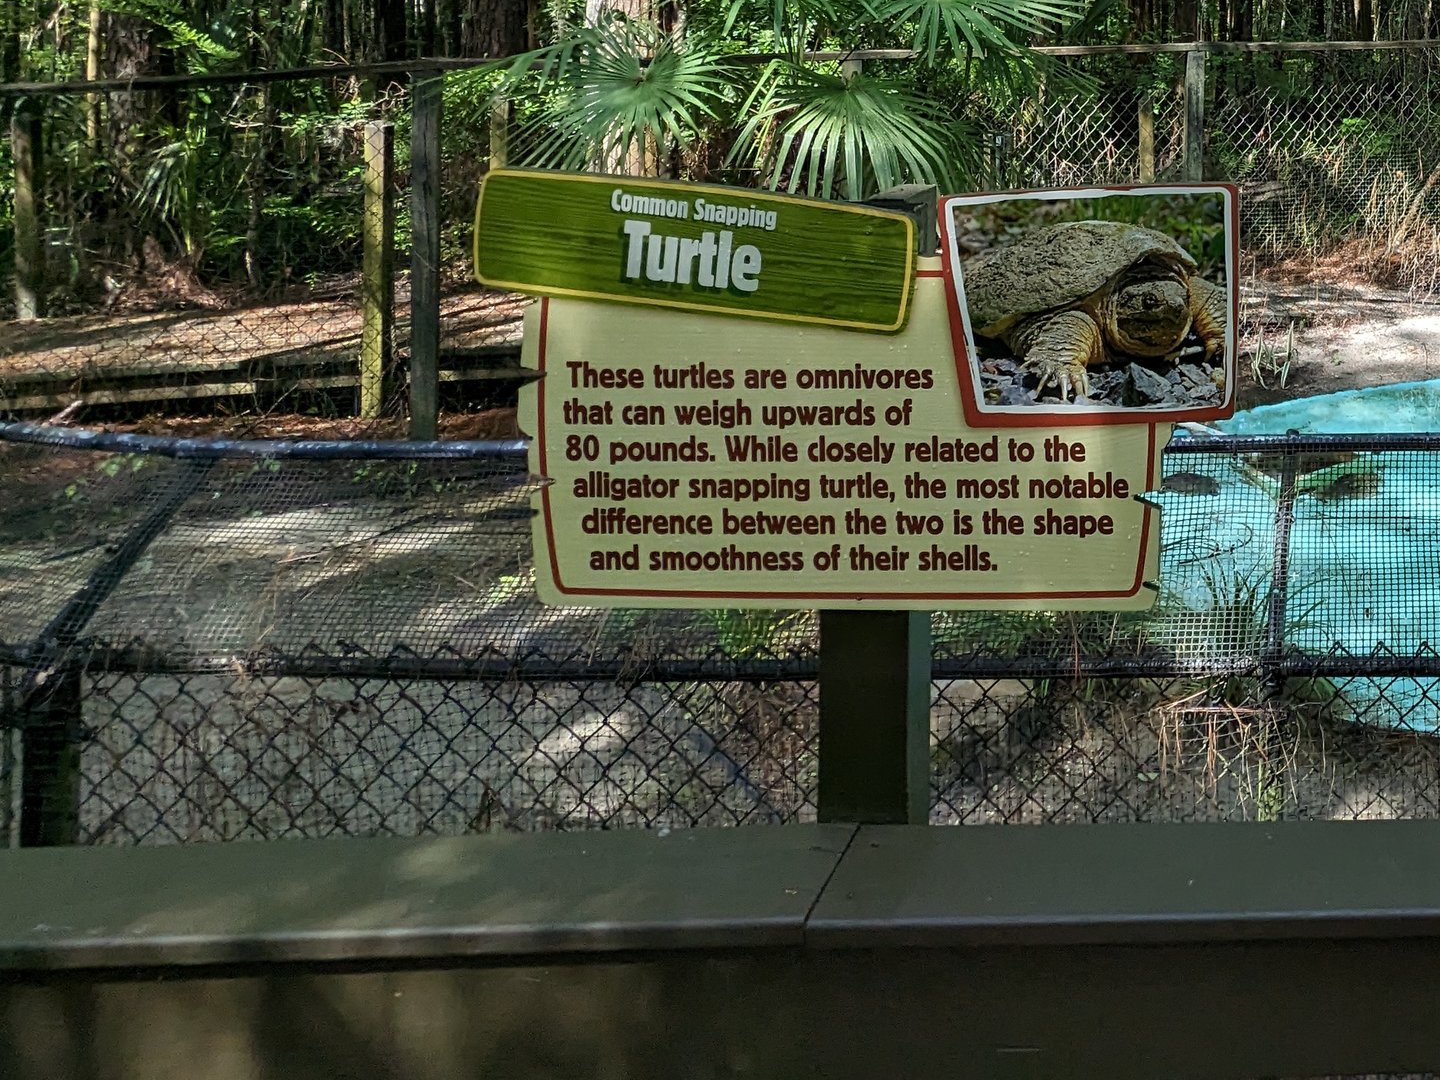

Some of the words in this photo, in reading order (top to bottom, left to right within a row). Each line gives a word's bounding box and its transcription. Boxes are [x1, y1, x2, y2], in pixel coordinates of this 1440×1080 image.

[611, 189, 689, 219] Common
[693, 198, 777, 231] Snapping
[623, 218, 762, 292] Turtle
[565, 360, 645, 390] These
[652, 360, 735, 390] turtles
[743, 368, 787, 390] are
[795, 362, 934, 390] omnivores
[562, 397, 614, 426] that
[621, 404, 666, 426] can
[673, 397, 753, 430] weigh
[761, 398, 876, 430] upwards
[884, 398, 913, 427] of
[565, 434, 600, 462] 80
[609, 434, 716, 466] pounds.
[723, 434, 799, 463] While
[807, 434, 896, 465] closely
[904, 434, 999, 463] related
[1007, 437, 1035, 463] to
[1043, 434, 1086, 463] the
[572, 470, 680, 502] alligator
[688, 472, 811, 503] snapping
[818, 471, 896, 503] turtle,
[903, 471, 947, 500] the
[956, 474, 1020, 500] most
[1028, 471, 1130, 500] notable
[581, 507, 714, 536] difference
[721, 507, 836, 536] between
[844, 507, 887, 536] the
[895, 510, 945, 536] two
[953, 508, 974, 536] is
[981, 507, 1025, 536] the
[1033, 507, 1114, 539] shape
[589, 543, 640, 571] and
[648, 543, 805, 572] smoothness
[812, 543, 842, 572] of
[848, 543, 910, 572] their
[917, 543, 998, 572] shells.
